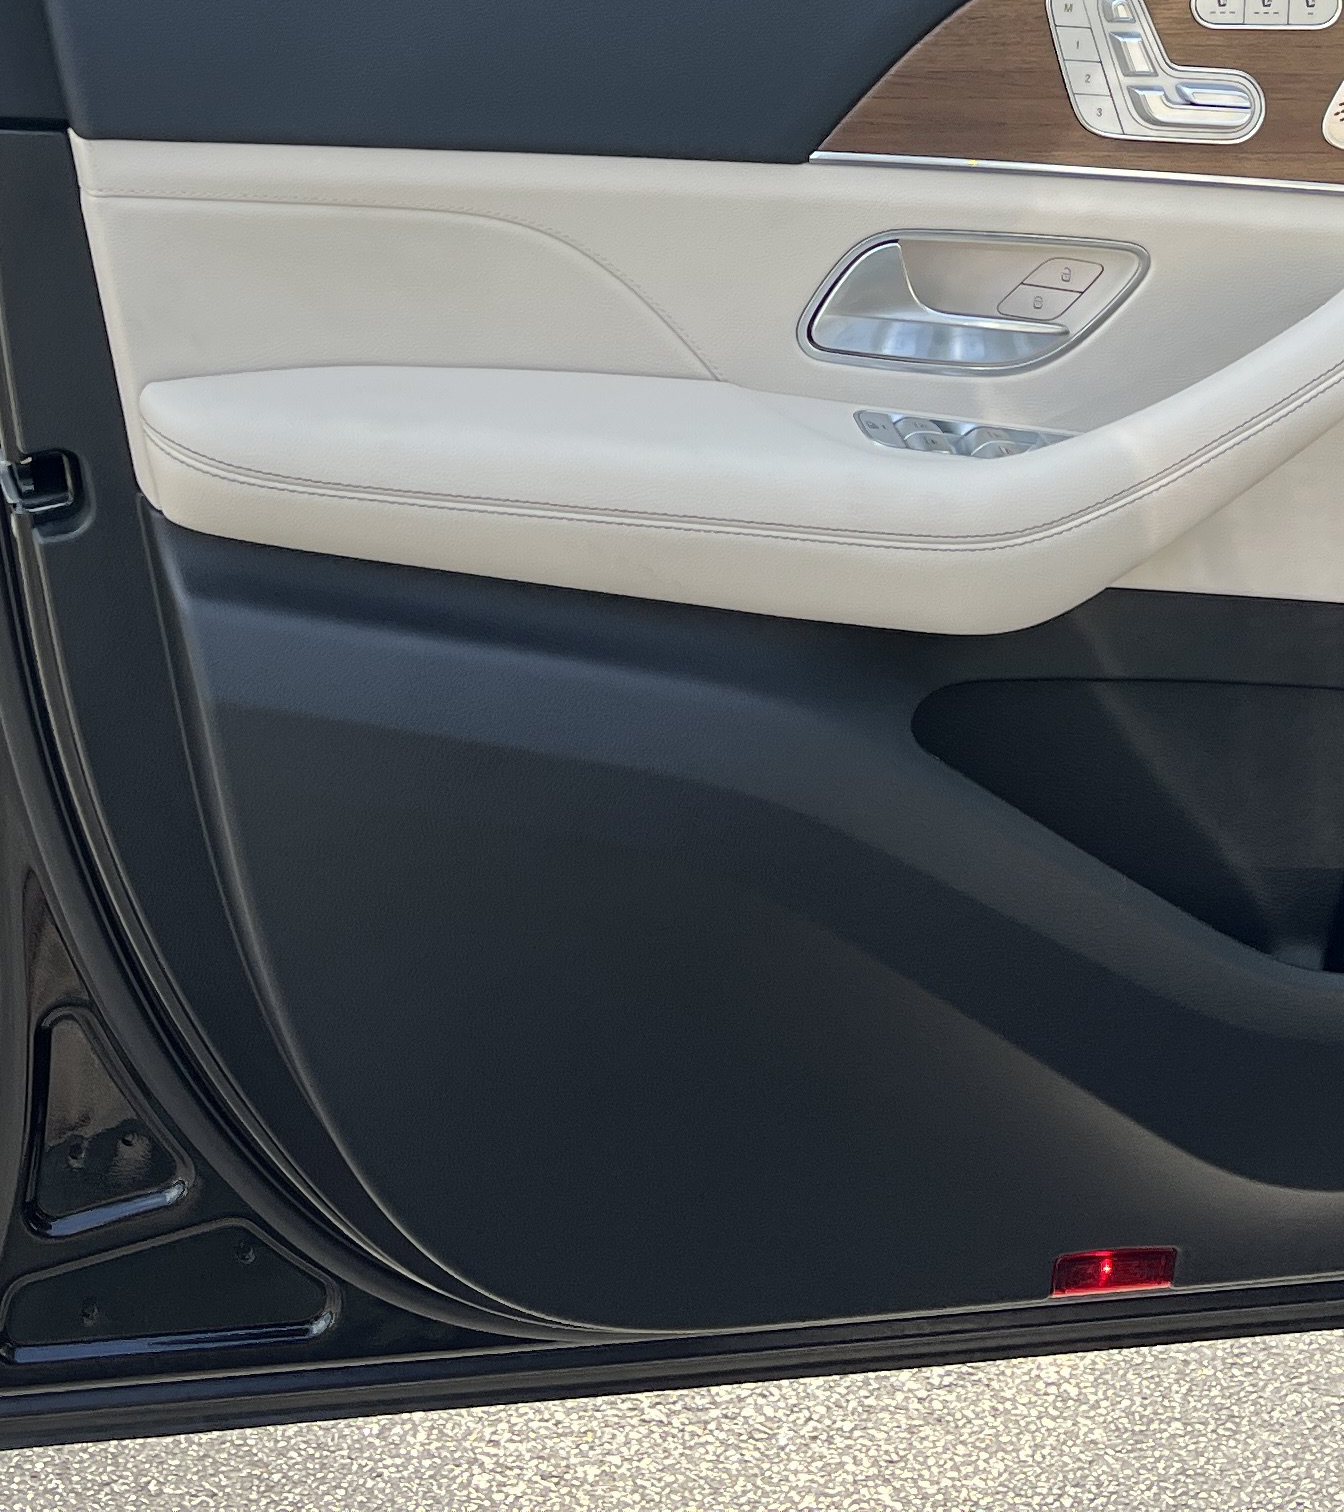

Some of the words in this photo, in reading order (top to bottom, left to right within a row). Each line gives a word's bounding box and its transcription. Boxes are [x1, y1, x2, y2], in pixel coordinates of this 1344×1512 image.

[1064, 3, 1073, 13] M
[1085, 74, 1092, 84] 2
[1096, 107, 1103, 117] 3
